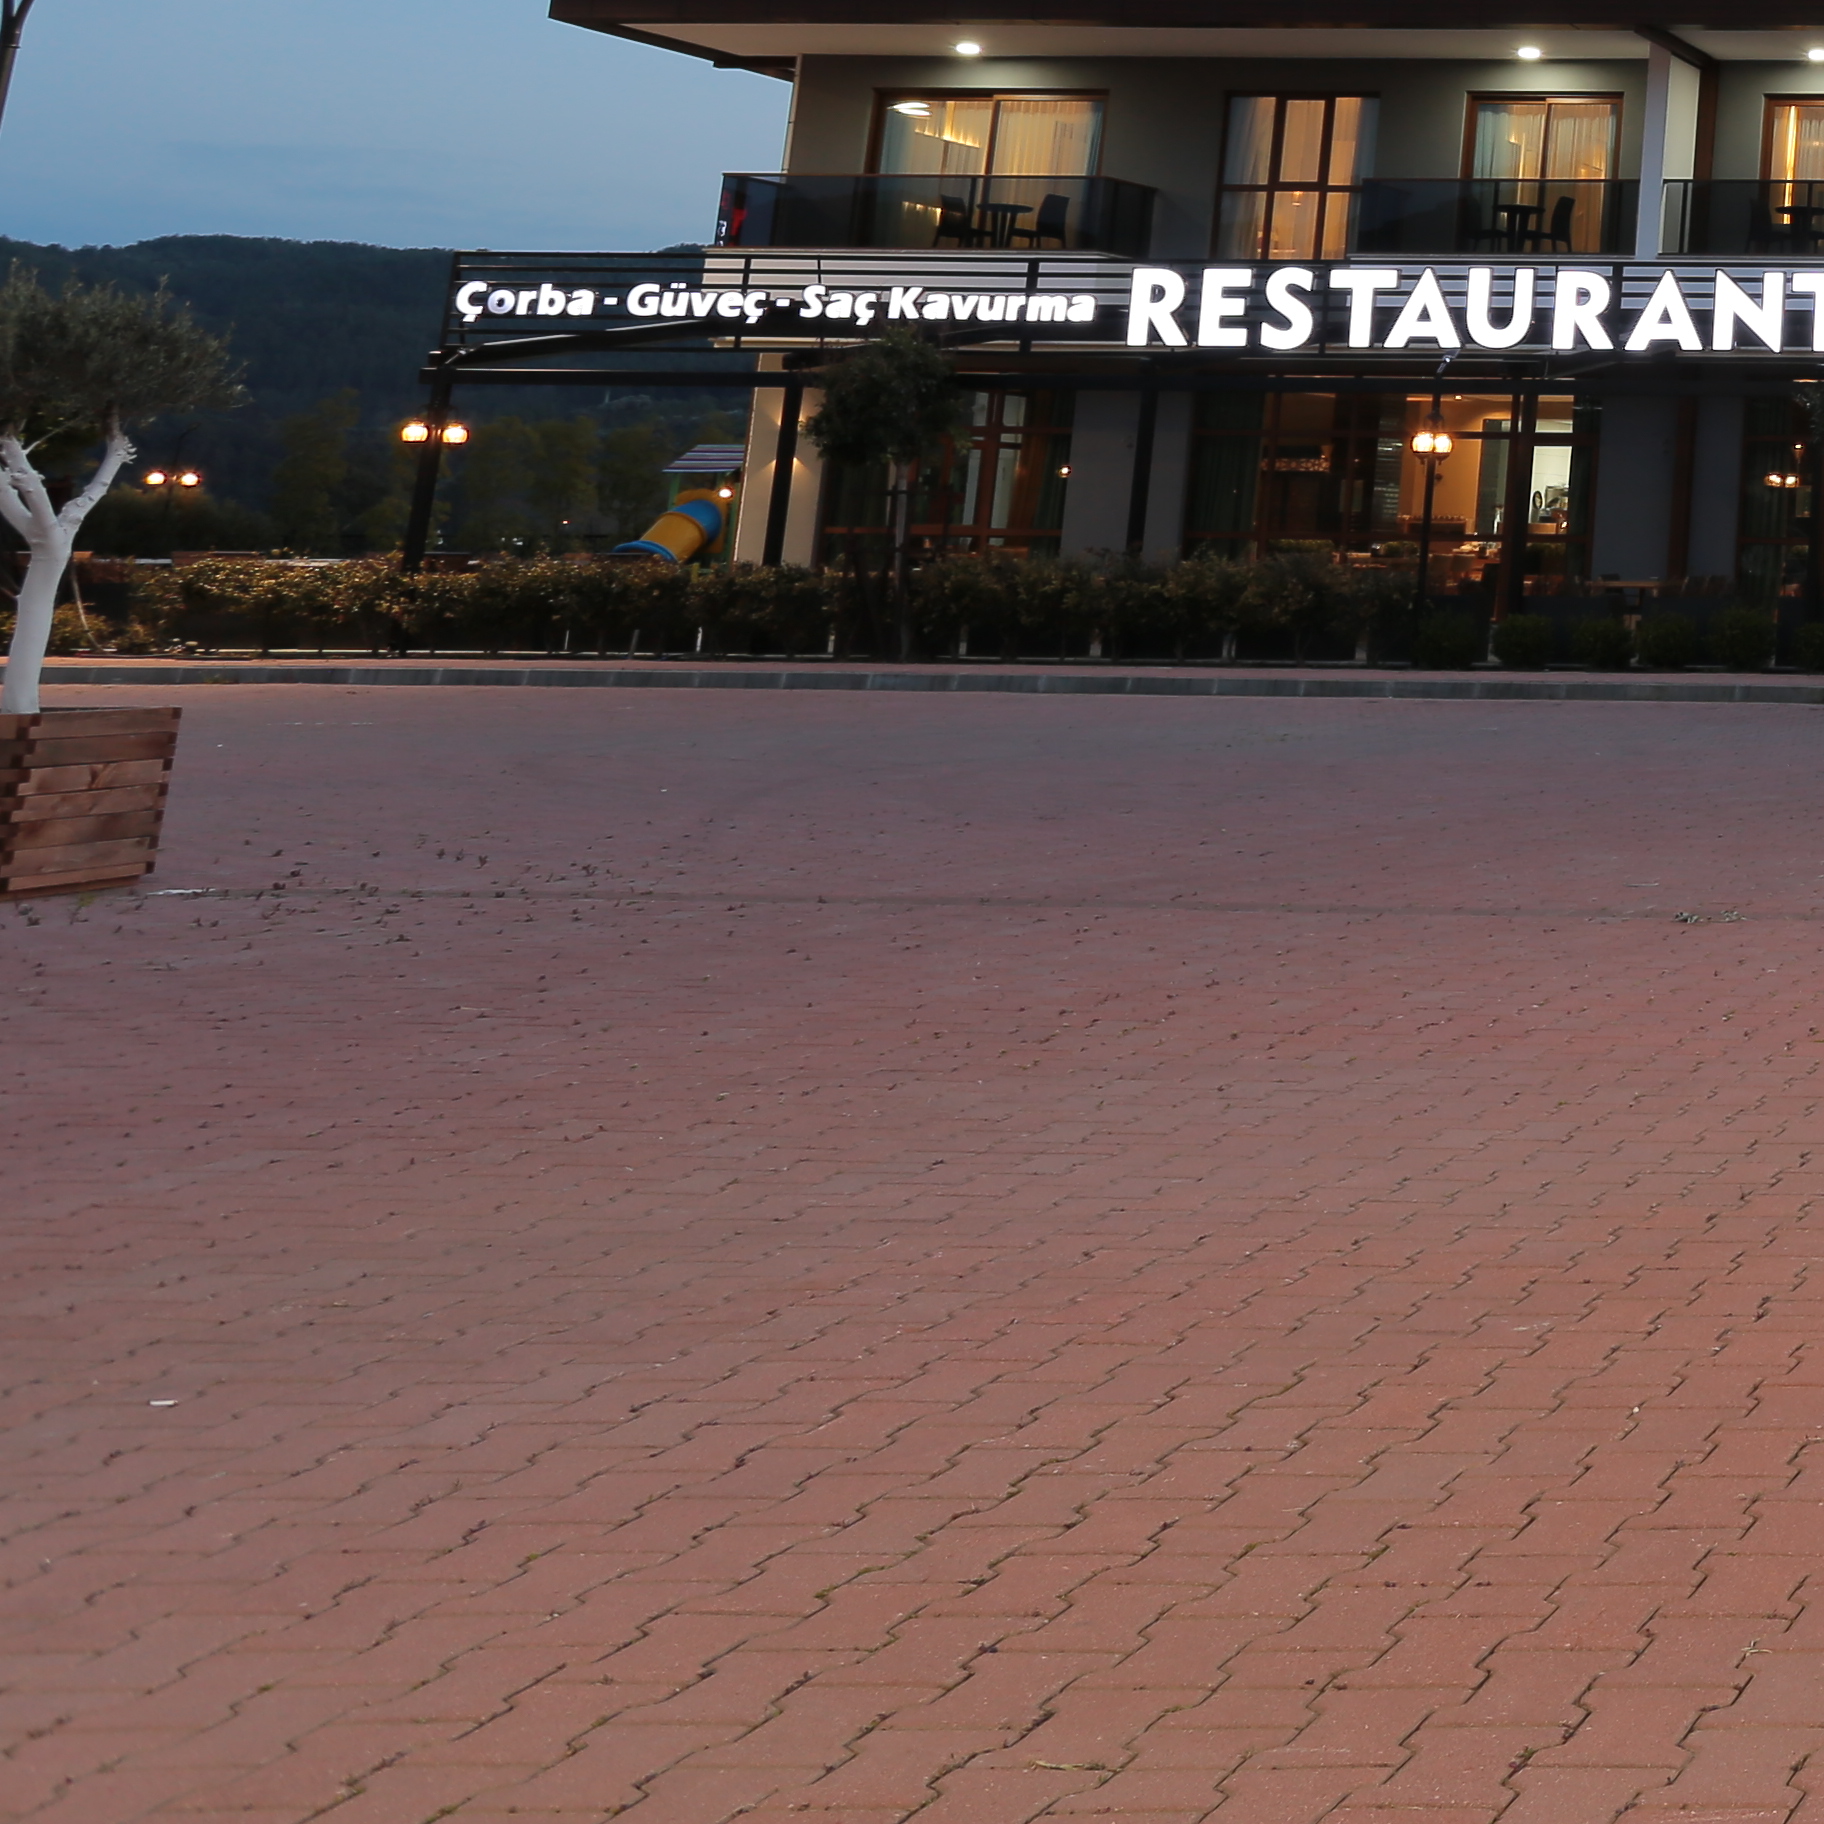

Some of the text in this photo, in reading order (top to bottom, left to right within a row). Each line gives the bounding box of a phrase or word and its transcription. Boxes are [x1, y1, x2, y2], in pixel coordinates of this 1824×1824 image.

[455, 280, 596, 323] Çorba
[626, 282, 767, 325] Güveç
[798, 283, 878, 327] Saç
[888, 286, 1097, 323] Kavurma
